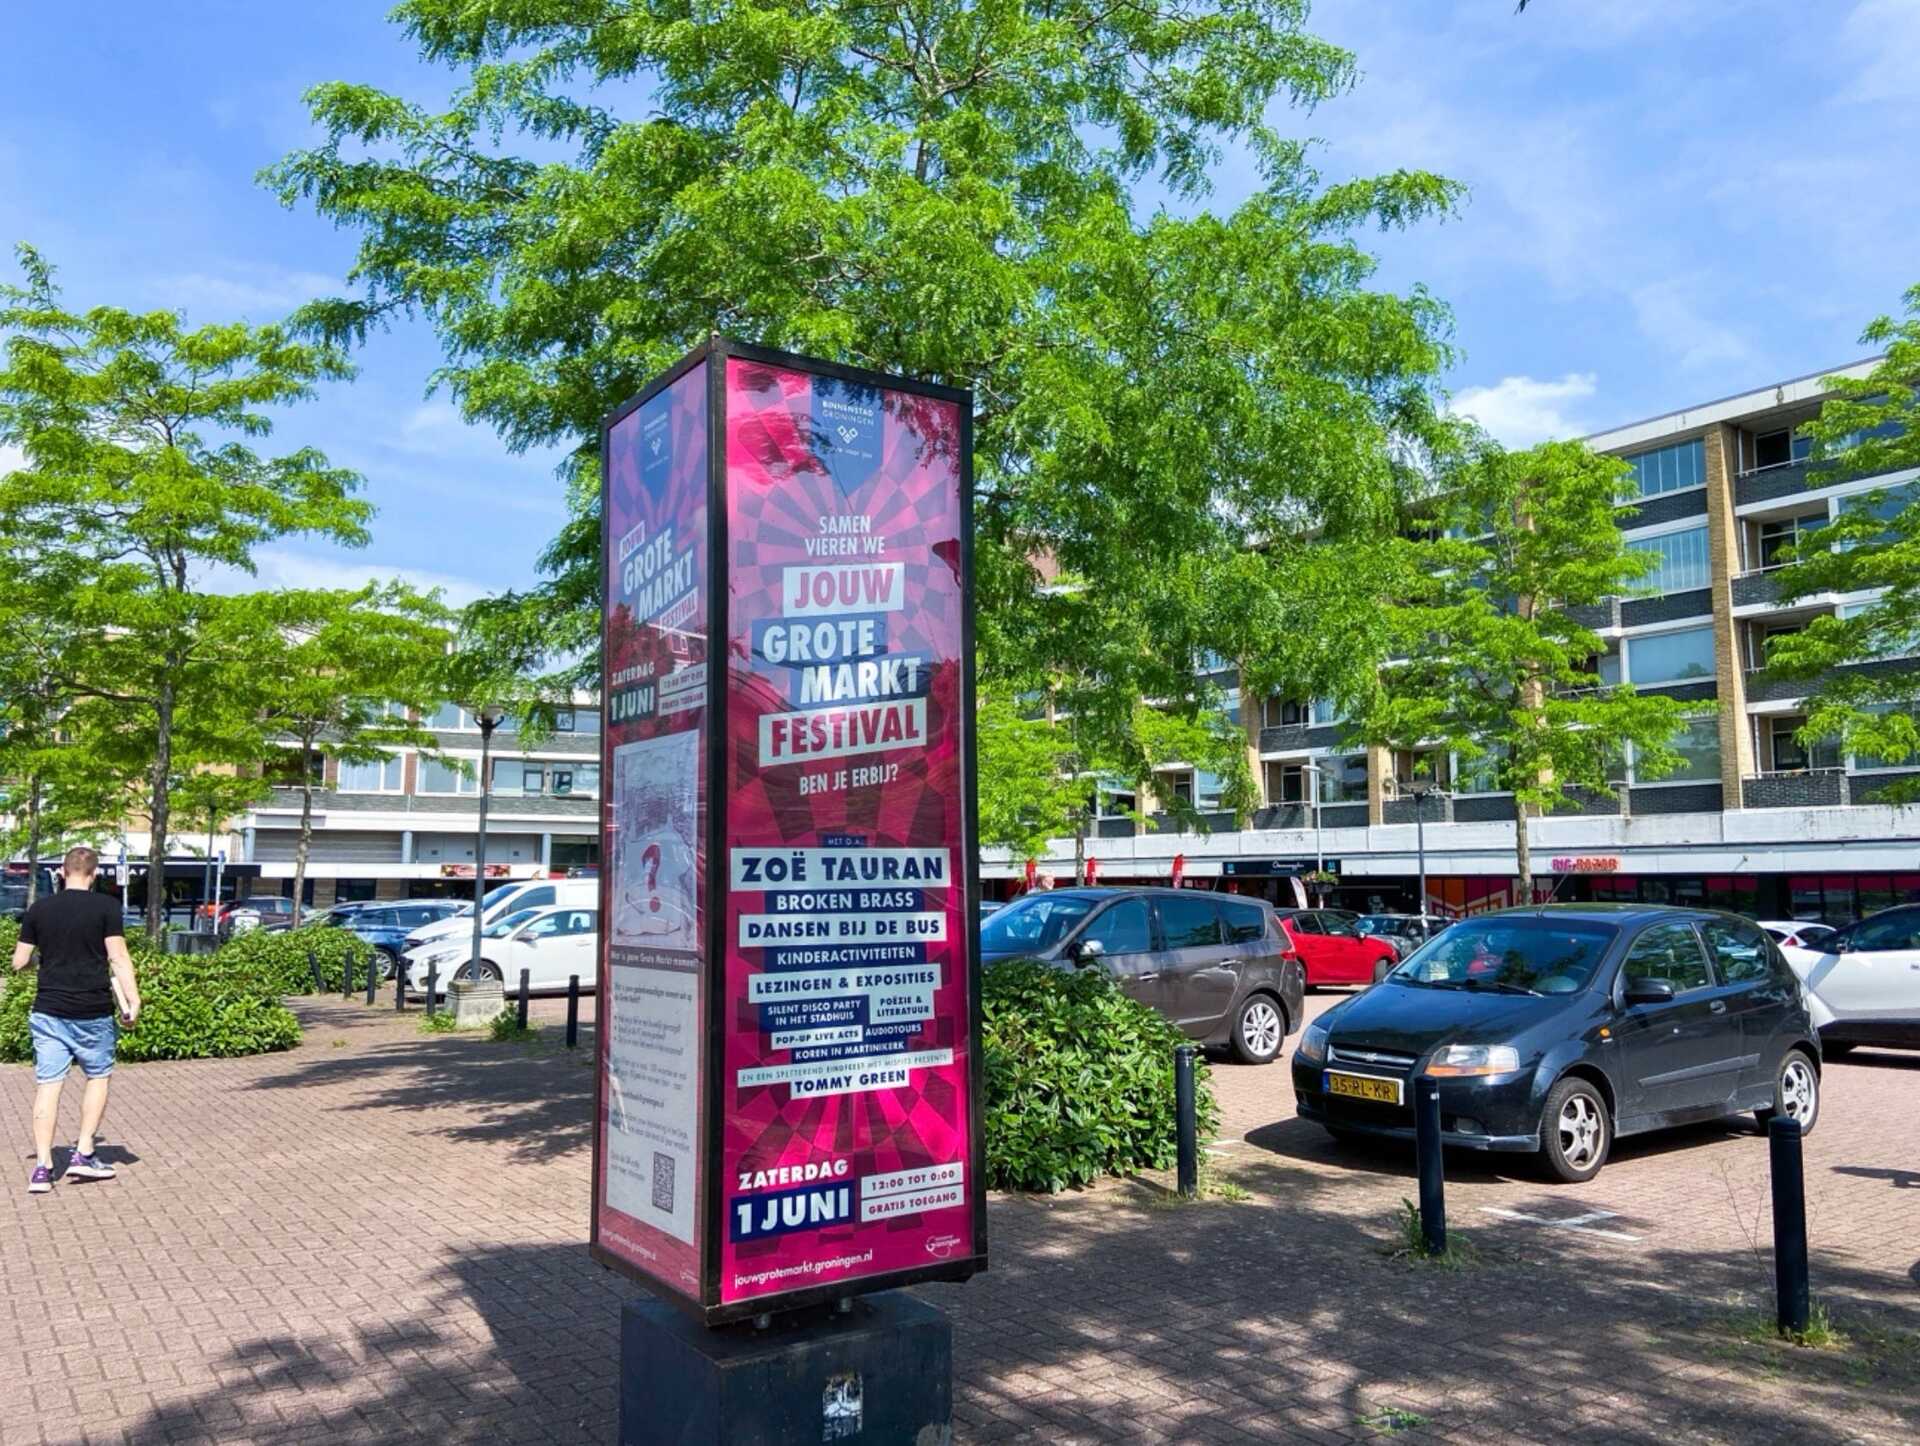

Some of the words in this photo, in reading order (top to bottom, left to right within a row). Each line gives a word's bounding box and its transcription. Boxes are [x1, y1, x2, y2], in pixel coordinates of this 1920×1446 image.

[820, 516, 871, 534] SAMEN
[804, 539, 859, 556] VIEREN
[862, 536, 886, 554] WE
[624, 528, 672, 596] GROTE
[640, 548, 693, 623] MARKT
[795, 568, 894, 608] JOUW
[763, 620, 874, 663] GROTE
[800, 658, 921, 704] MARKT
[620, 686, 654, 718] JUNI
[772, 704, 919, 757] FESTIVAL
[800, 776, 828, 796] BEN
[833, 771, 848, 791] JE
[852, 764, 898, 787] ERBIJ?
[741, 851, 806, 882] ZOË
[822, 856, 942, 880] TAURAN
[776, 893, 852, 910] BROKEN
[860, 892, 914, 908] BRASS
[748, 922, 830, 938] DANSEN
[839, 922, 866, 936] BIJ
[876, 920, 898, 935] DE
[906, 920, 940, 934] BUS
[777, 946, 916, 965] KINDERACTIVITEITEN
[756, 977, 832, 994] LEZINGEN
[838, 976, 848, 988] &
[856, 972, 935, 988] EXPOSITIES
[768, 1003, 799, 1016] SILENT
[802, 1001, 830, 1013] DISCO
[832, 1000, 862, 1011] PARTY
[916, 996, 922, 1004] &
[776, 1014, 787, 1026] IN
[790, 1014, 808, 1024] HET
[810, 1011, 854, 1024] STADHUIS
[877, 1005, 930, 1018] LITERATUUR
[776, 1034, 812, 1044] POP-UP
[815, 1032, 834, 1042] LIVE
[837, 1030, 860, 1040] ACTS
[866, 1023, 922, 1037] AUDIOTOURS
[795, 1048, 828, 1060] KOREN
[831, 1046, 842, 1056] IN
[844, 1040, 905, 1056] MARTINIKERK
[795, 1076, 852, 1093] TOMMY
[860, 1070, 906, 1086] GREEN
[739, 1159, 848, 1190] ZATERDAG
[872, 1178, 904, 1190] 12:00
[908, 1174, 926, 1184] TOT
[930, 1170, 955, 1182] 0:00
[737, 1204, 752, 1234] 1
[761, 1188, 848, 1230] JUNI
[868, 1201, 905, 1214] GRATIS
[910, 1192, 957, 1208] TOEGANG
[734, 1249, 872, 1289] jouwgrotemarkt.groningen.nl
